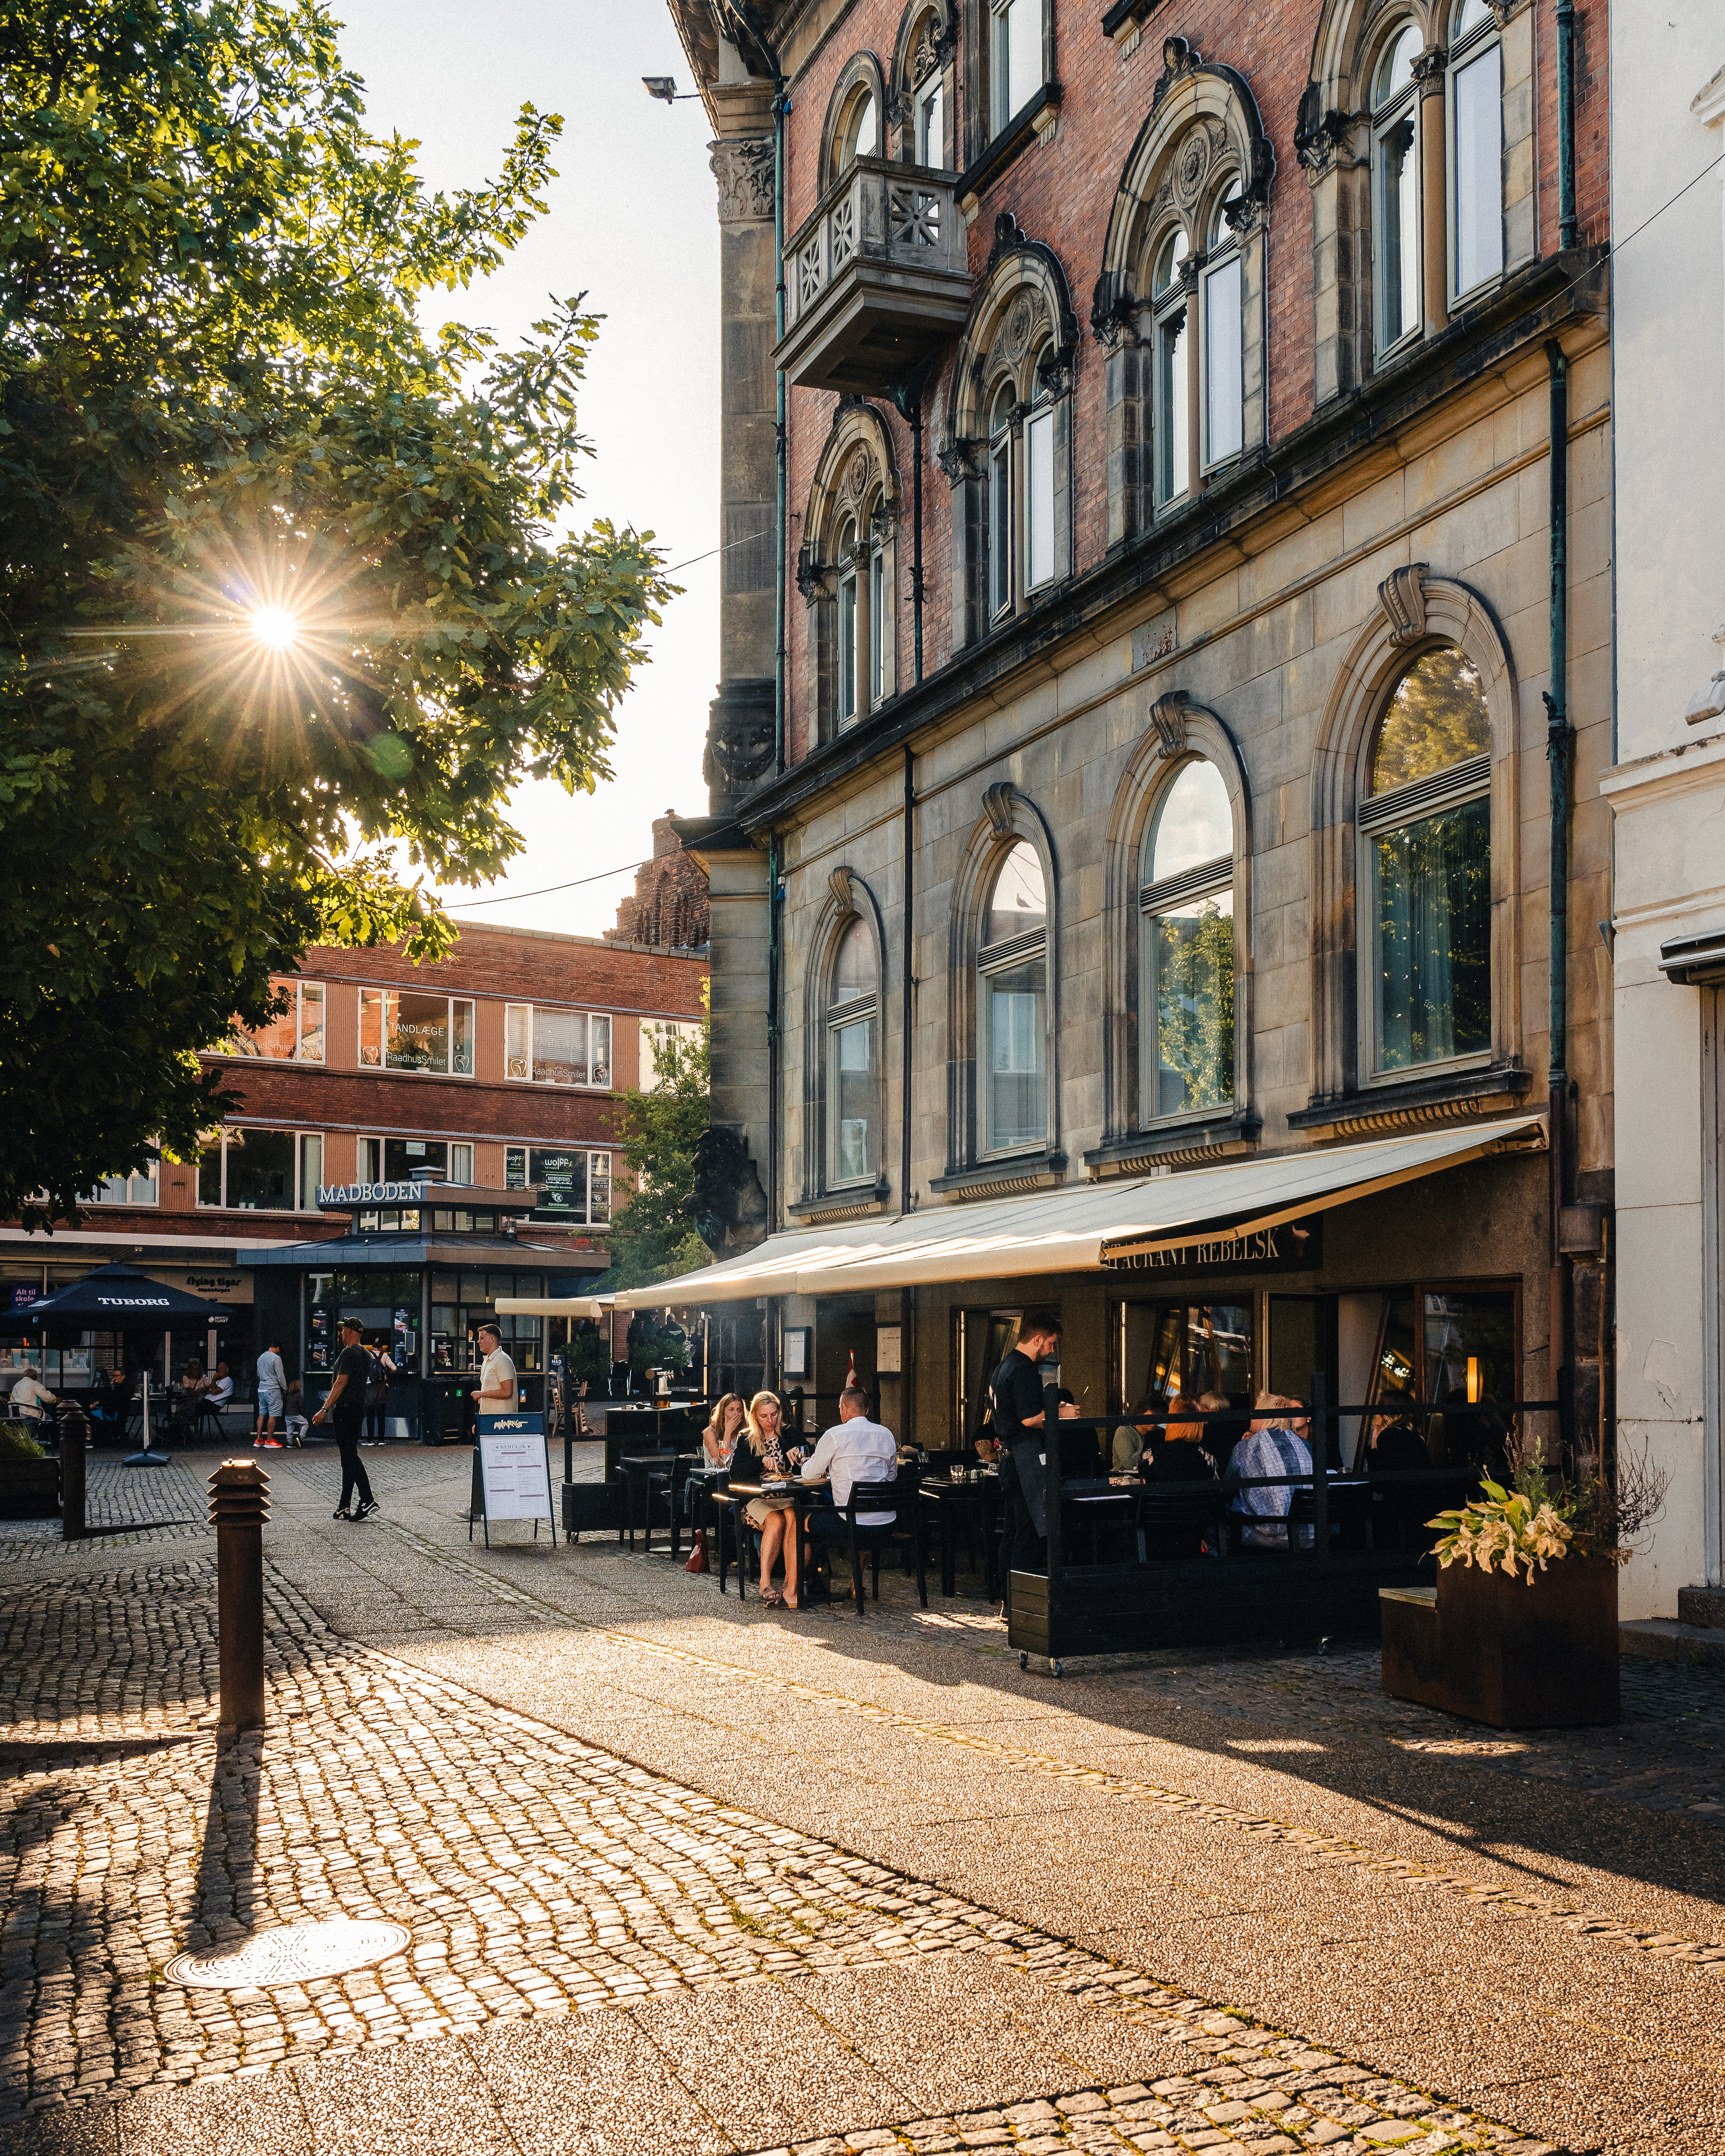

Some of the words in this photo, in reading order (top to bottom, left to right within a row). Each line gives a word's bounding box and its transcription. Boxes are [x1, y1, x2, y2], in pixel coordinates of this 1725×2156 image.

[390, 1023, 444, 1036] TANDLÆGE
[230, 1038, 294, 1052] RaadhusSmilet
[387, 1052, 446, 1066] RaadhusSmilet
[533, 1066, 586, 1079] RaadhusSmilet
[319, 1181, 422, 1202] MADBODEN
[1196, 1228, 1280, 1263] REBELSK
[186, 1276, 215, 1287] flying
[216, 1277, 242, 1288] tiger
